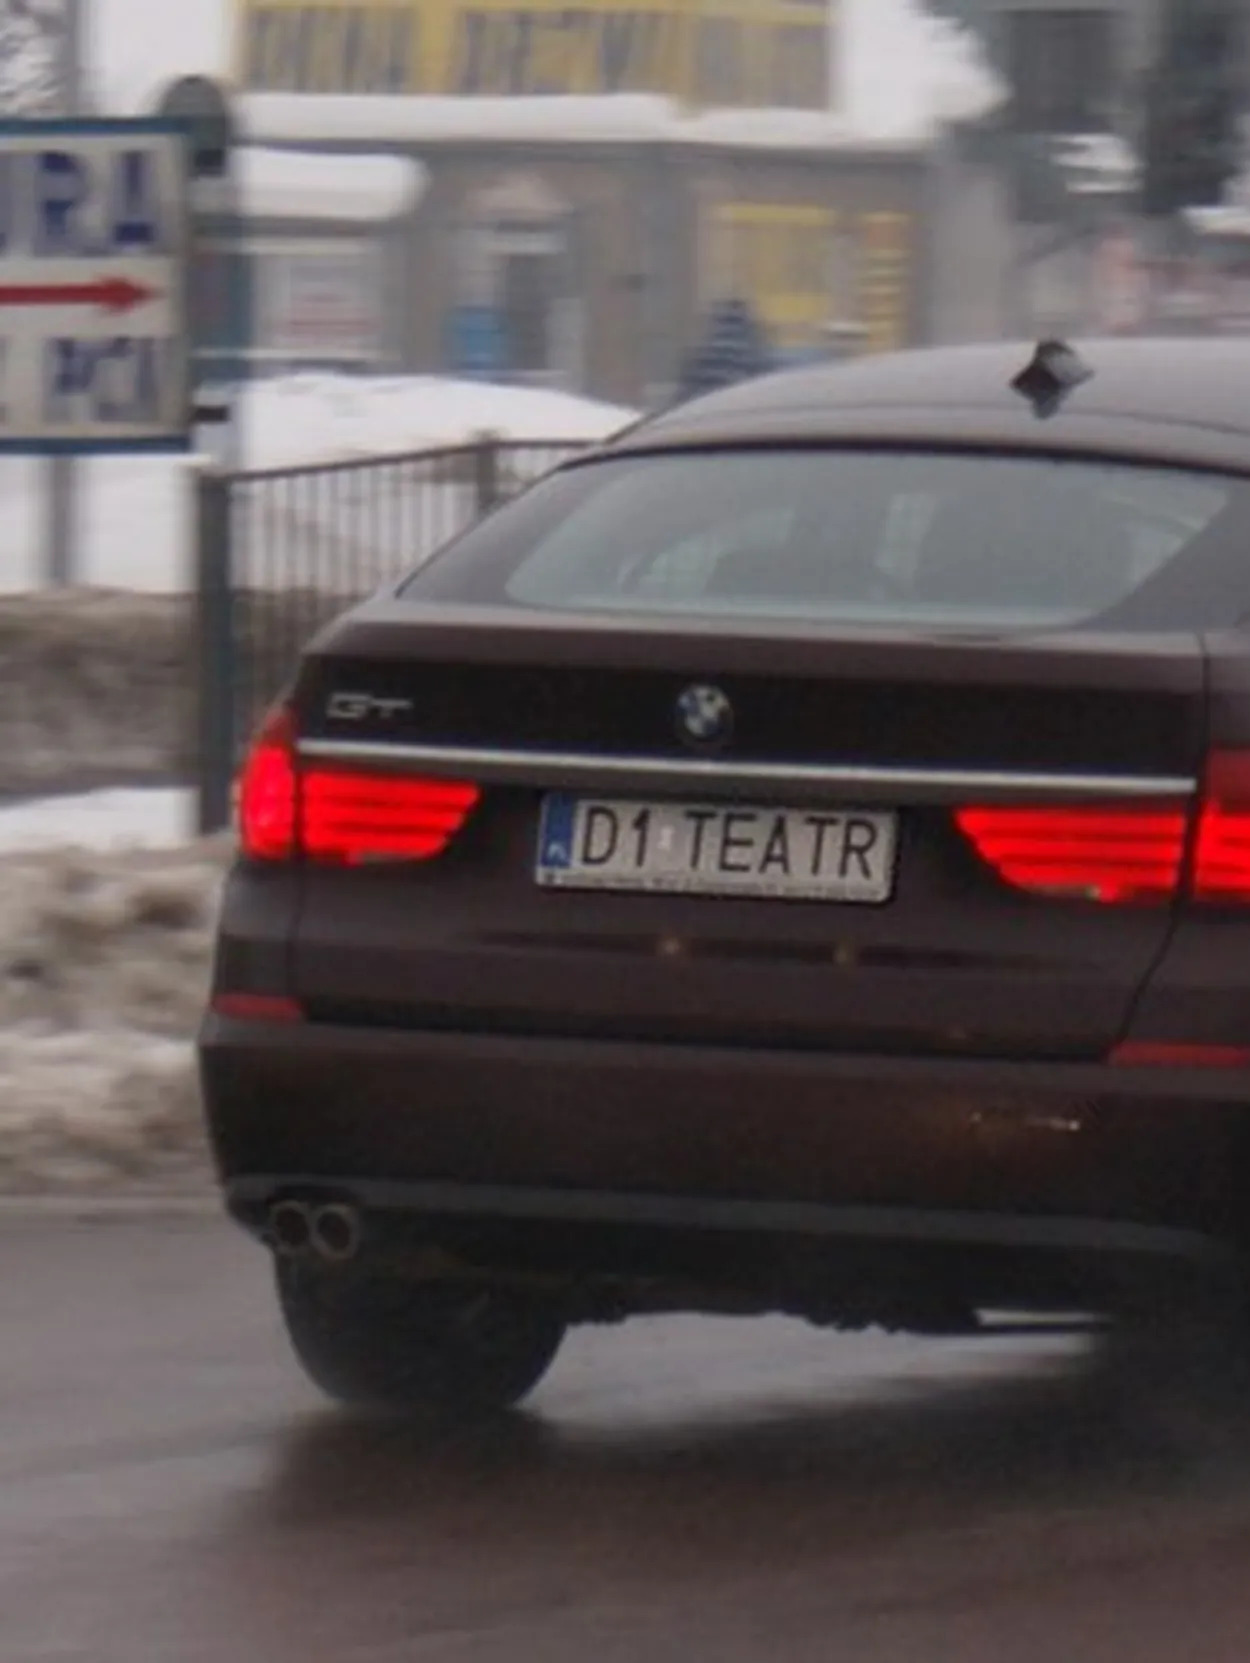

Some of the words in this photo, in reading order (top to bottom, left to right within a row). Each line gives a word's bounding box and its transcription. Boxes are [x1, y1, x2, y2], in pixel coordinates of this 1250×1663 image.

[325, 692, 413, 720] GT
[582, 806, 651, 868] D1
[684, 810, 878, 879] TEATR
